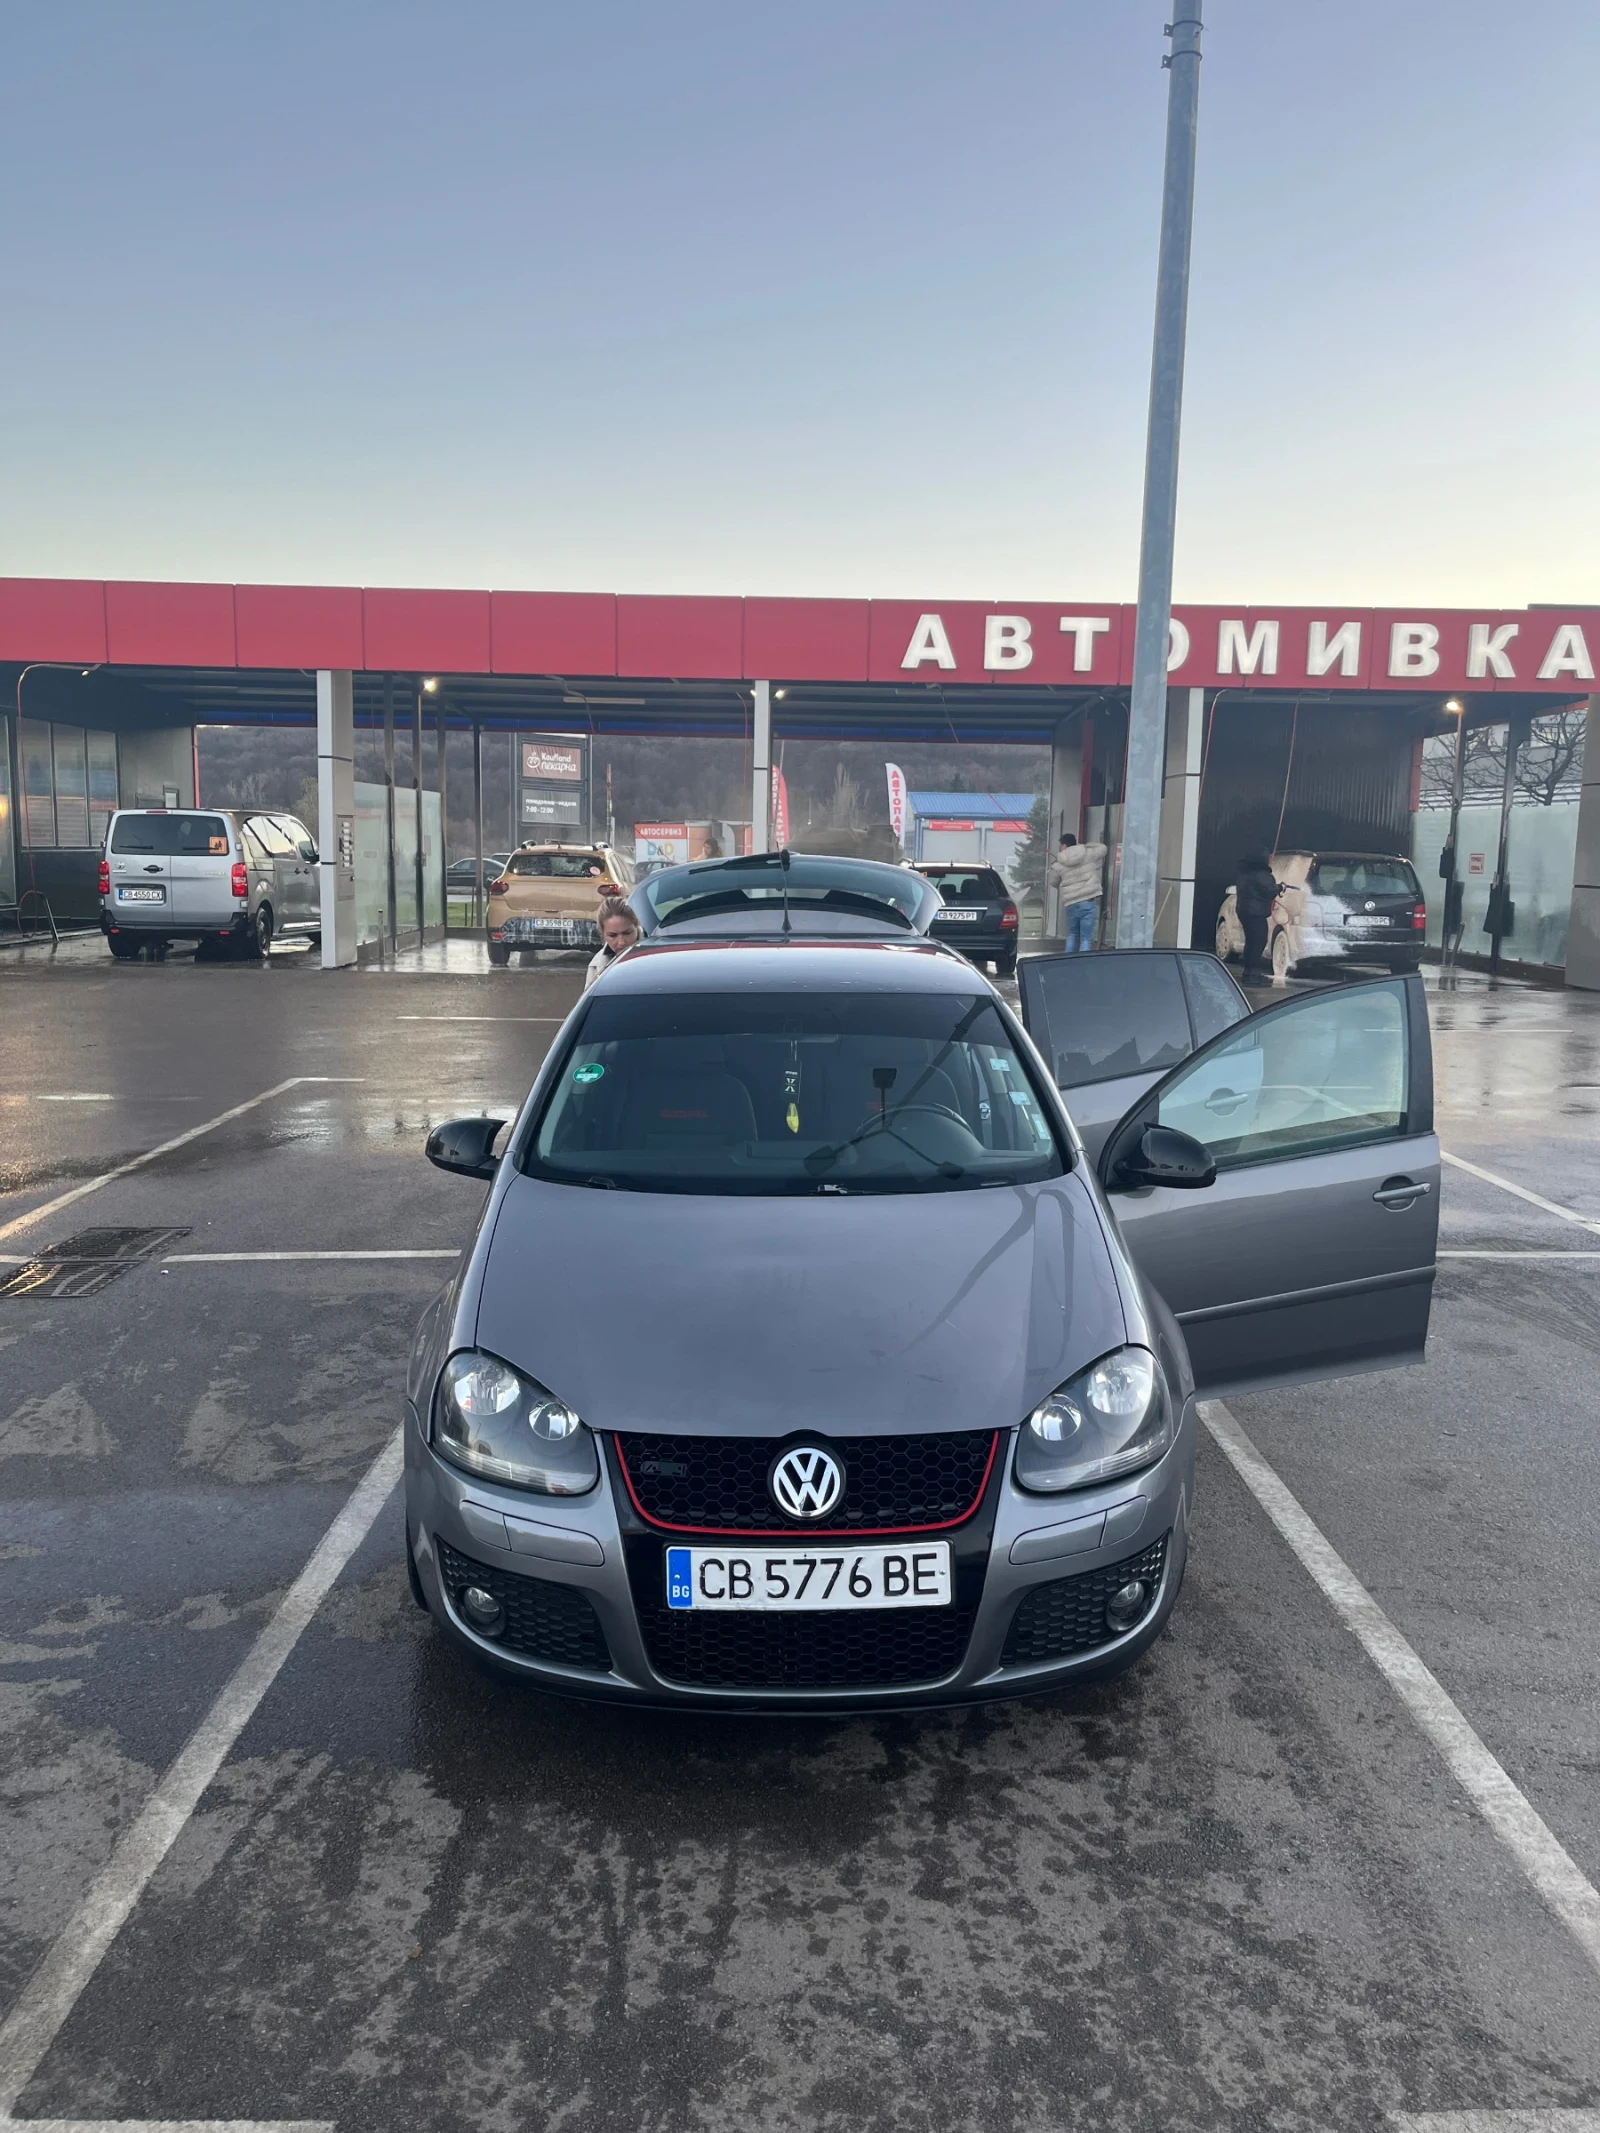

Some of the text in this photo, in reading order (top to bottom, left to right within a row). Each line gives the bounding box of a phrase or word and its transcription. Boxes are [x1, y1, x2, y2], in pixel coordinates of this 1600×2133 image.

[541, 752, 571, 762] Kaufland
[640, 827, 683, 836] АВТОСЕРВИЗ
[699, 1552, 939, 1600] CB 5776 BE
[672, 1585, 690, 1598] BG
